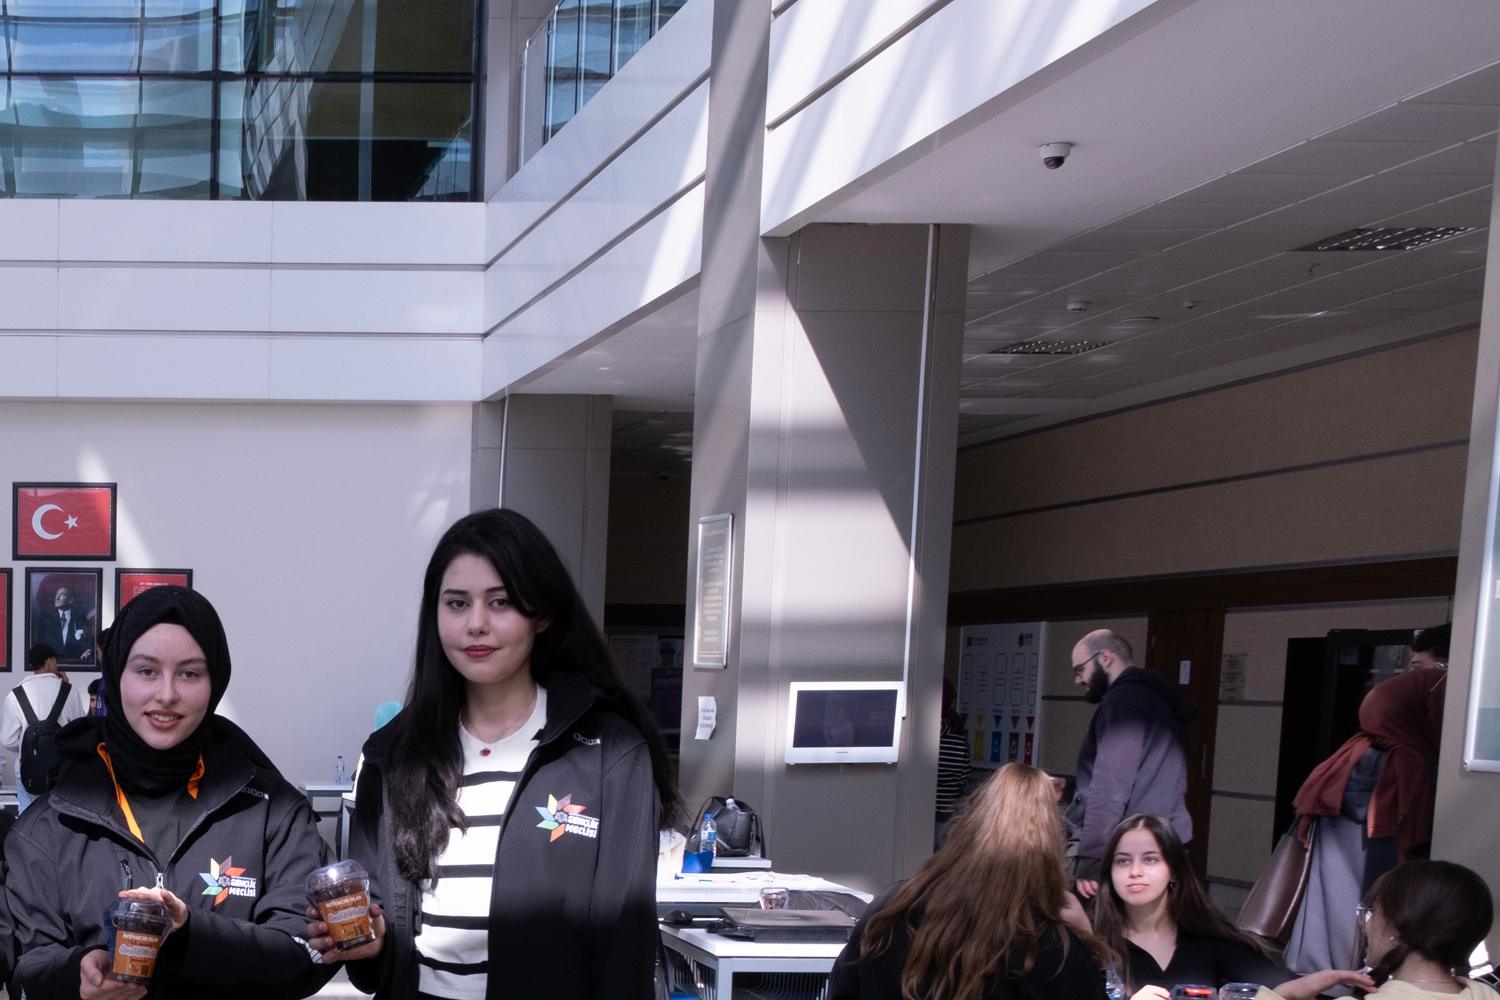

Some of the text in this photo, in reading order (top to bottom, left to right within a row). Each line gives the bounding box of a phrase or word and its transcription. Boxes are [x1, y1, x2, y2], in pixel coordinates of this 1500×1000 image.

[568, 816, 599, 829] GENÇLİK
[565, 824, 597, 838] MECLİSİ
[230, 878, 256, 889] GENÇLİK
[228, 887, 256, 897] MECLİSİ
